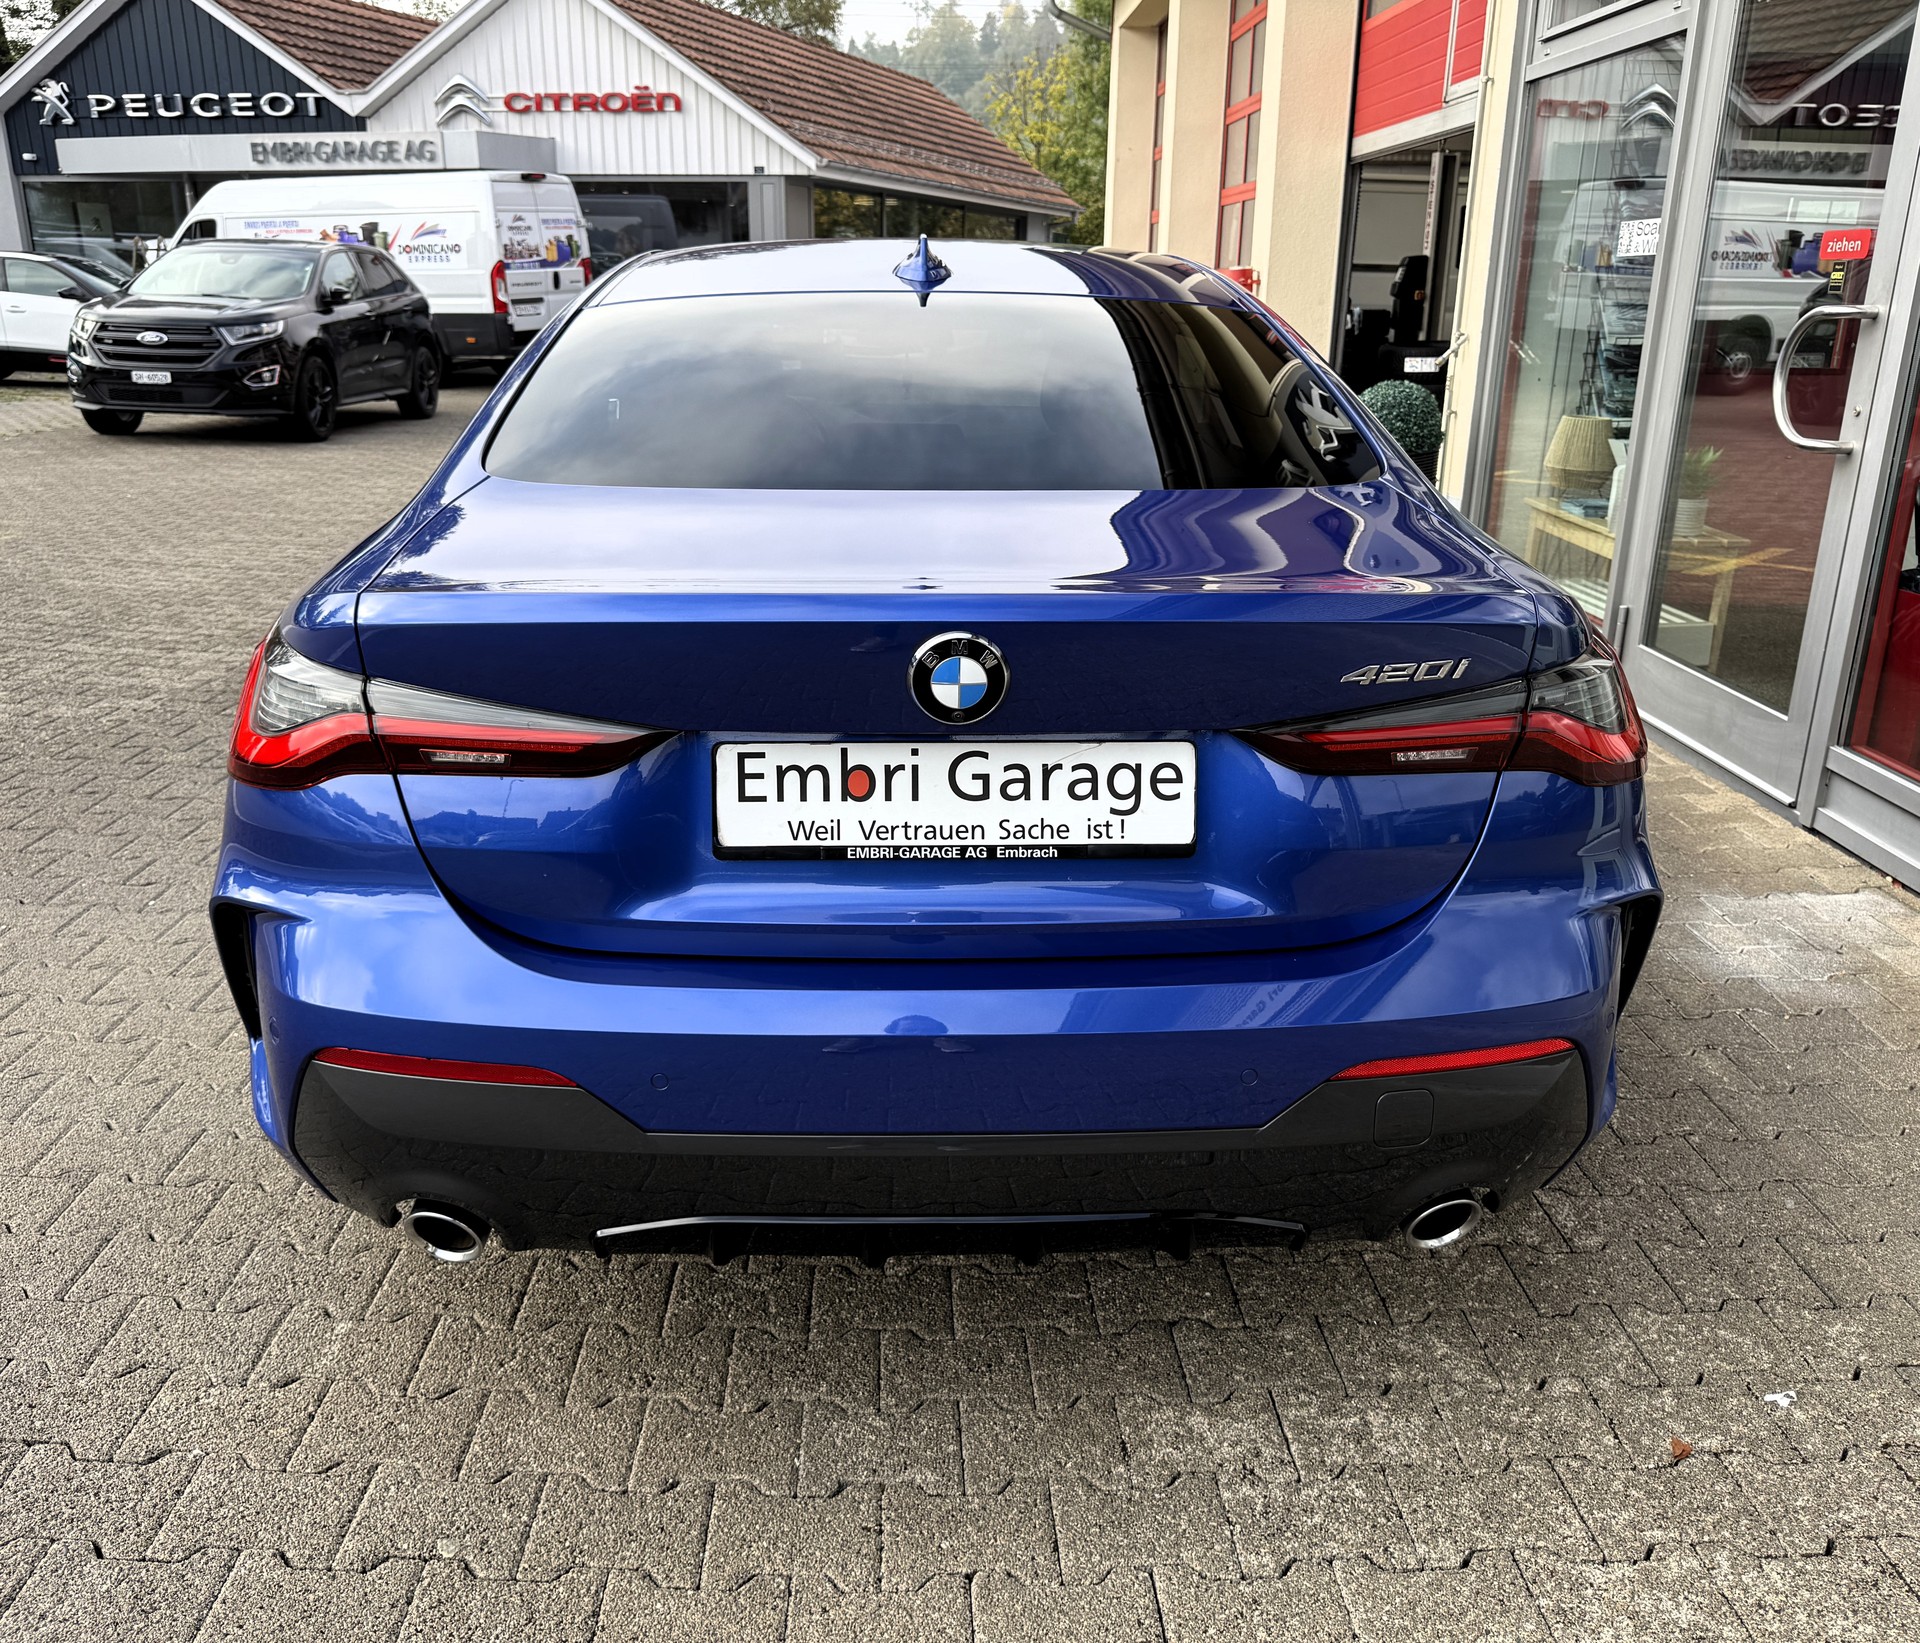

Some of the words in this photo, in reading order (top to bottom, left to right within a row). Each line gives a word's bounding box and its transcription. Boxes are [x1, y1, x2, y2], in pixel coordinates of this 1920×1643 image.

[87, 92, 325, 118] PEUGEOT
[503, 85, 682, 113] CITROËN
[404, 139, 437, 163] AG
[398, 243, 462, 255] DOMINICANO
[1827, 236, 1862, 252] ziehen
[409, 255, 451, 263] EXPRESS
[921, 640, 999, 669] BMW
[1340, 658, 1472, 685] 420i
[737, 747, 920, 803] Embri
[947, 750, 1184, 816] Garage
[787, 818, 842, 841] Weil
[858, 819, 985, 841] Vertrauen
[998, 817, 1070, 841] Sache
[846, 846, 961, 859] EMBRI-GARAGE
[965, 846, 988, 859] AG
[996, 846, 1058, 859] Embrach
